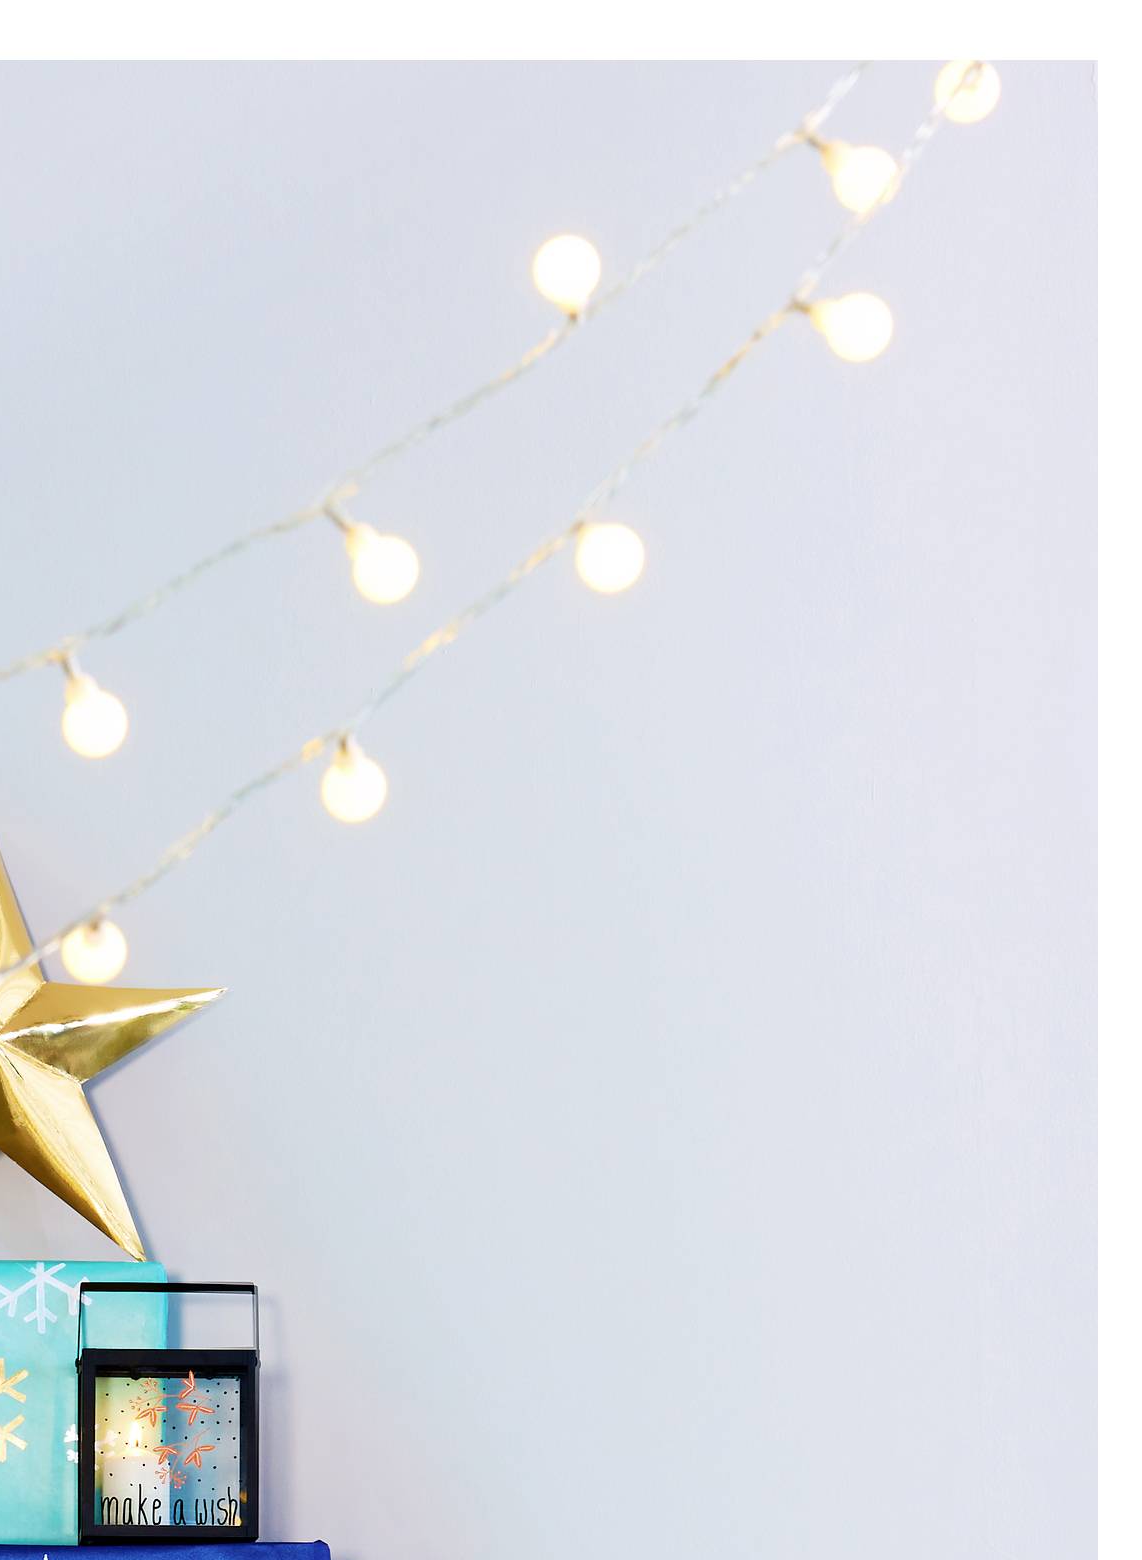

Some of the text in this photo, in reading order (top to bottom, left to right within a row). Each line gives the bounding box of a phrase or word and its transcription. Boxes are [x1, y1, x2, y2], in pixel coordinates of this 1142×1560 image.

[100, 1484, 239, 1526] make a wish
